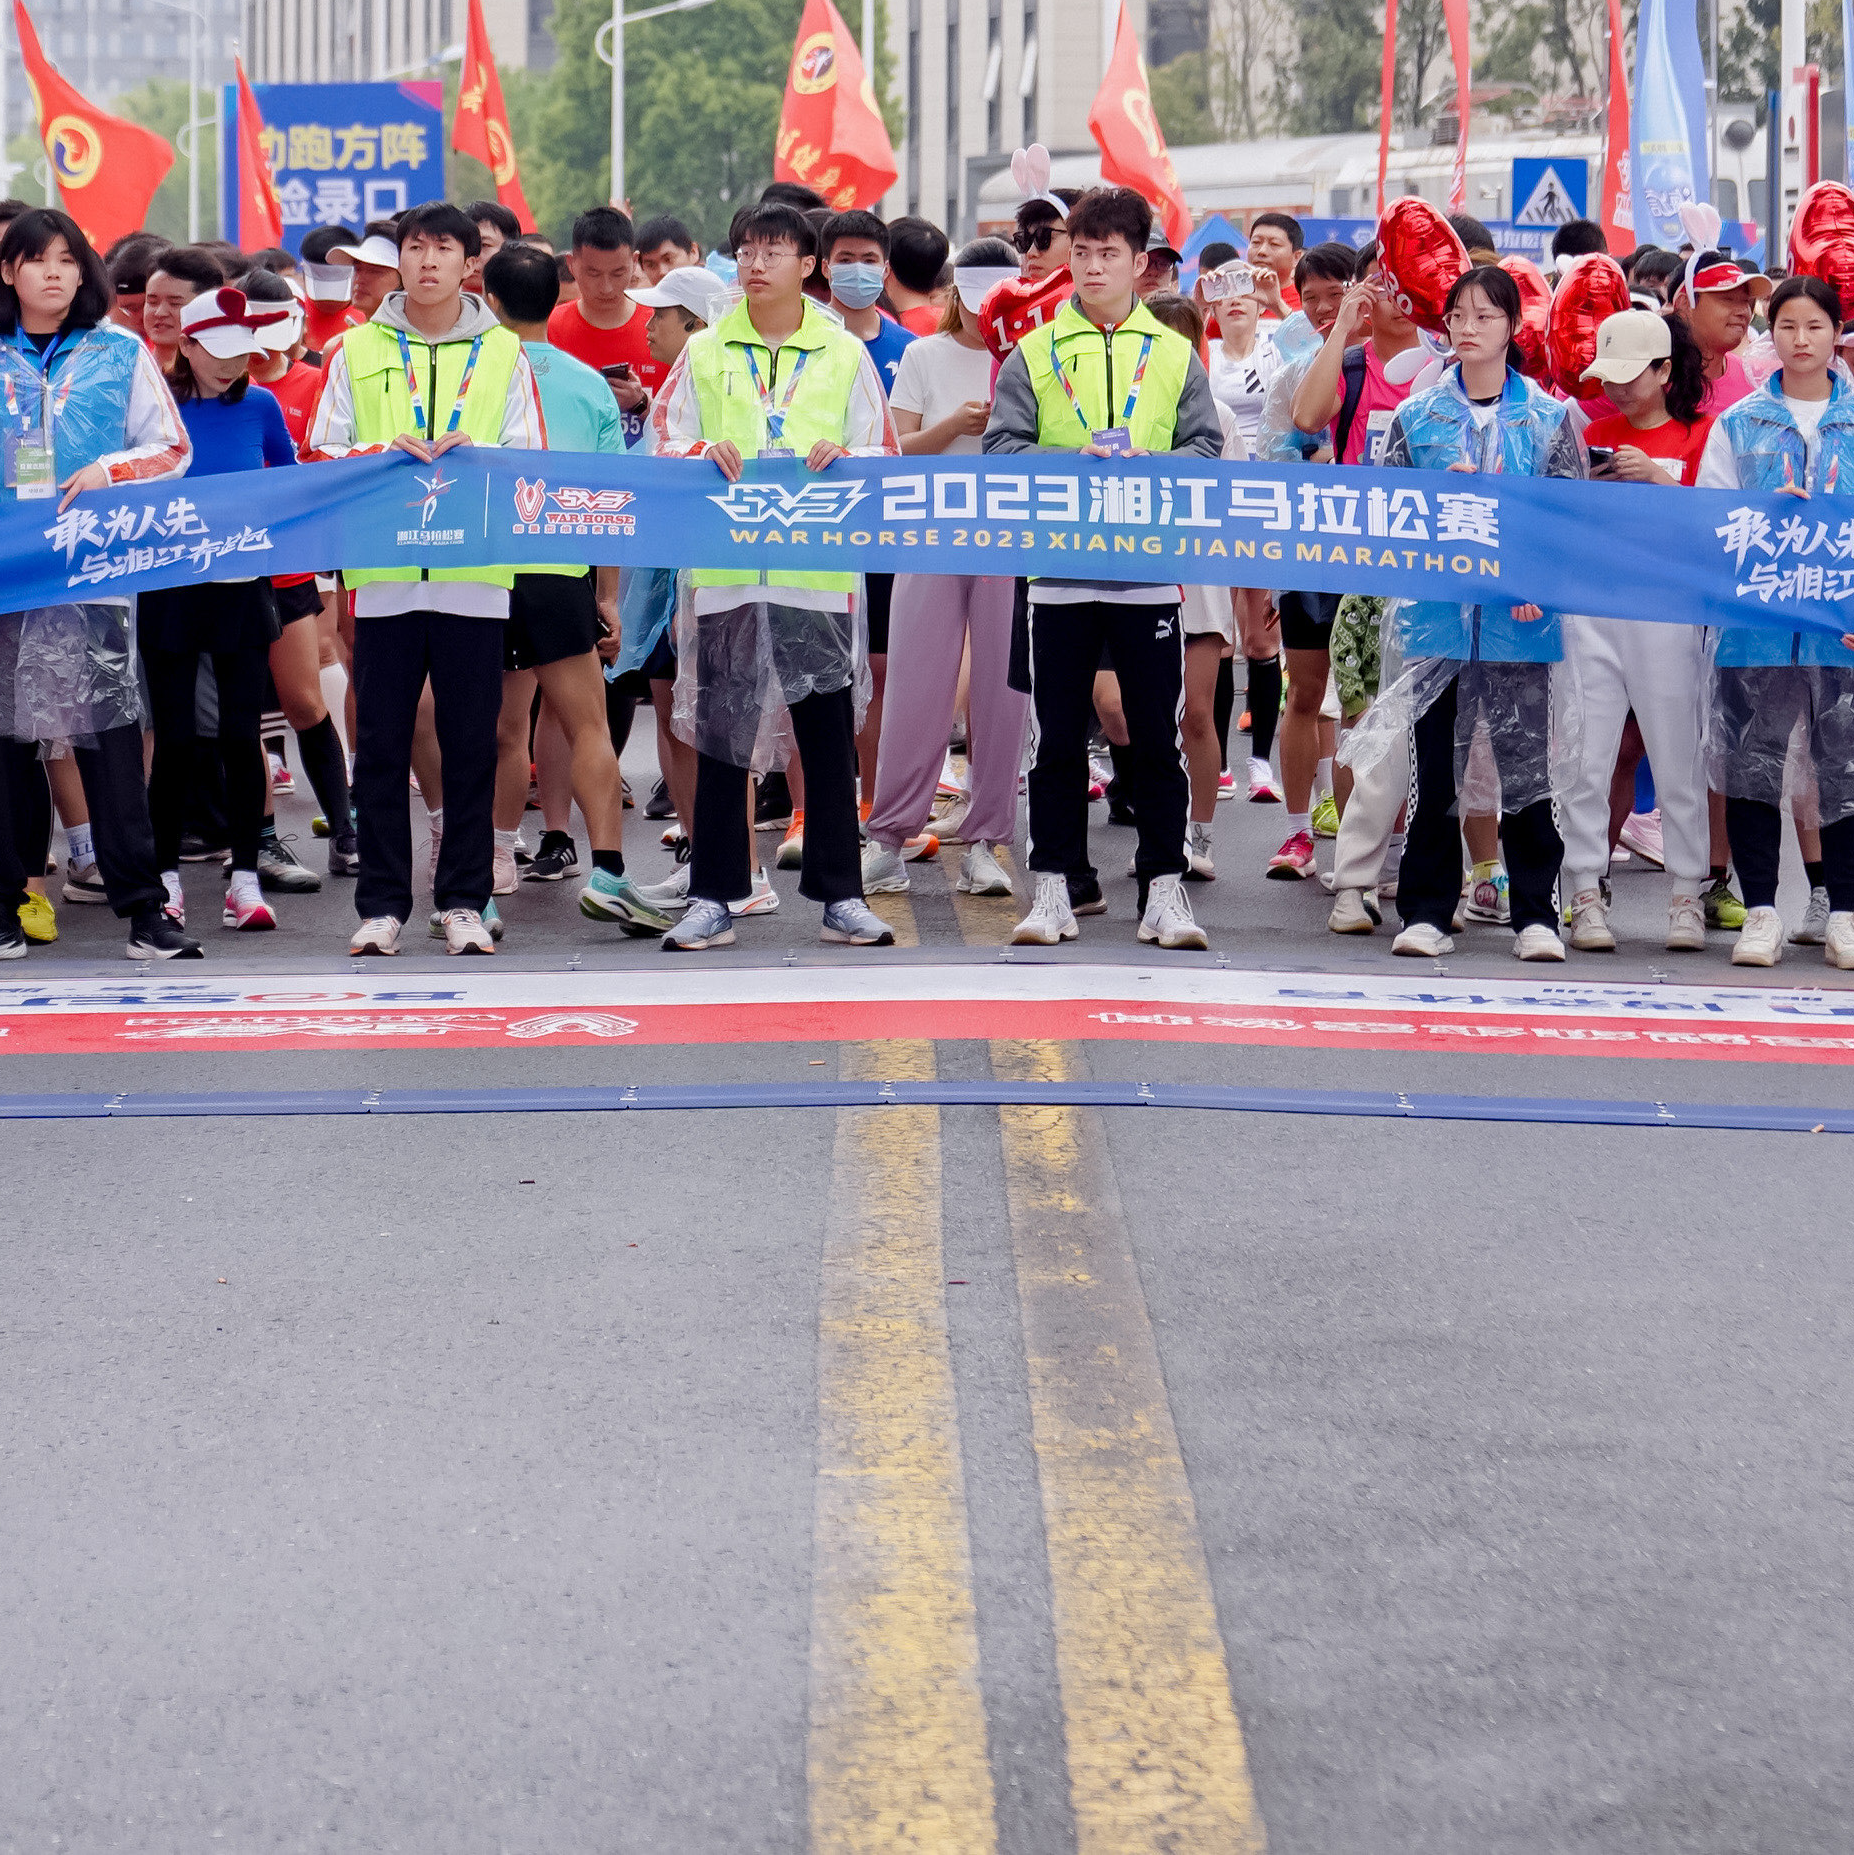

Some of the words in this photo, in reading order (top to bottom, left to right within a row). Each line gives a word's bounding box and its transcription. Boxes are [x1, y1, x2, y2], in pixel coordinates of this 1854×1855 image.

[44, 496, 210, 559] 敢为人先
[546, 513, 581, 524] WAR
[583, 514, 636, 526] HORSE
[881, 473, 1501, 549] 2023湘江马拉松赛
[67, 525, 275, 589] 与湘江奔跑
[729, 528, 808, 545] WAR
[821, 528, 941, 547] HORSE
[952, 529, 1036, 550] 2023
[1047, 531, 1163, 555] XIANG
[1174, 536, 1284, 562] JIANG
[1297, 543, 1502, 578] MARATHON
